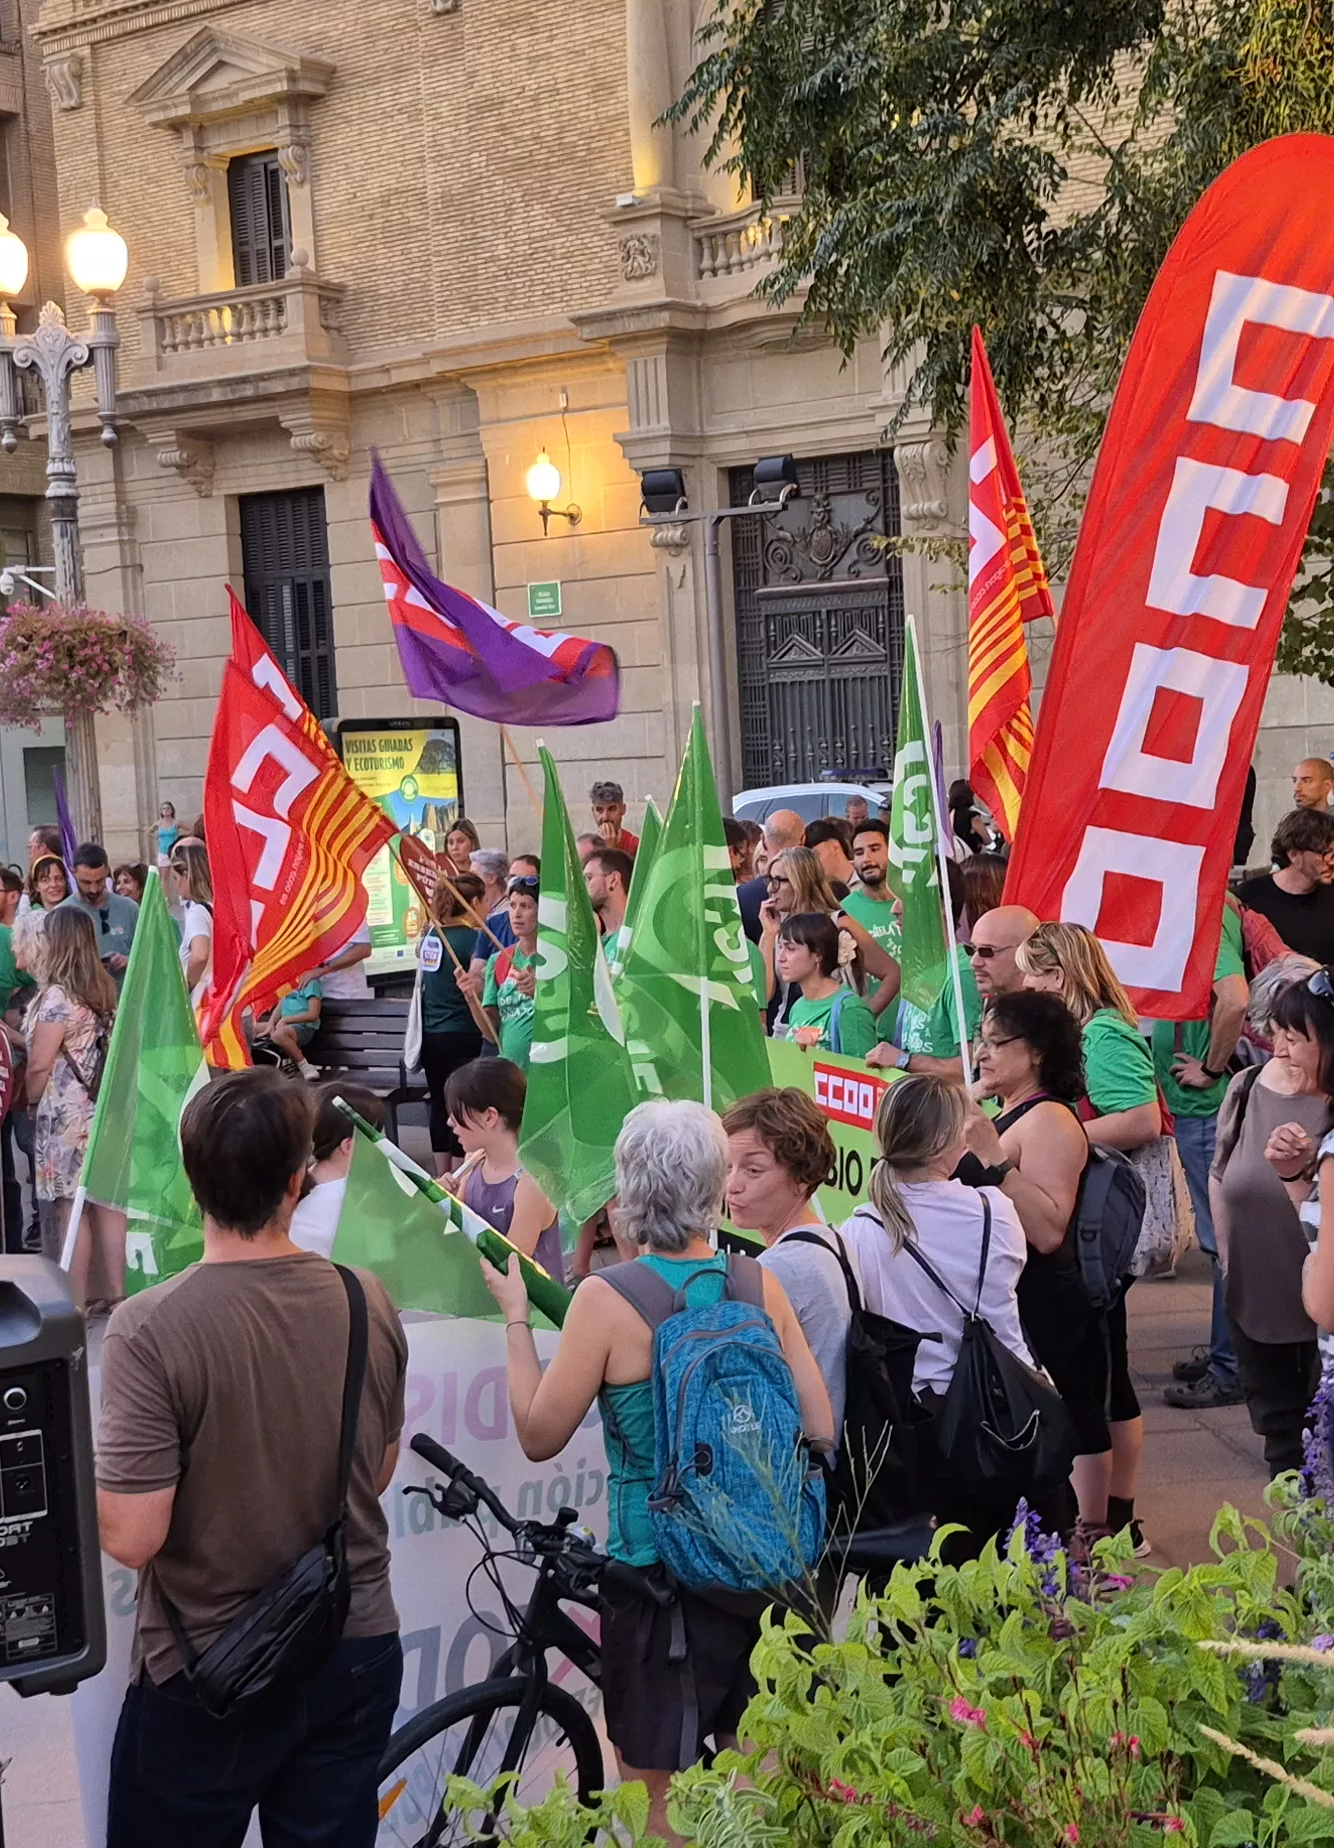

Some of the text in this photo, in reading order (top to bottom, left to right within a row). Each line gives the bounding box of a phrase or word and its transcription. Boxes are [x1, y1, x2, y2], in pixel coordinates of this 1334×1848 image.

[345, 737, 413, 754] VISITAS GUIADAS
[354, 756, 405, 771] ECOTURISMO
[814, 1070, 874, 1119] CCOO
